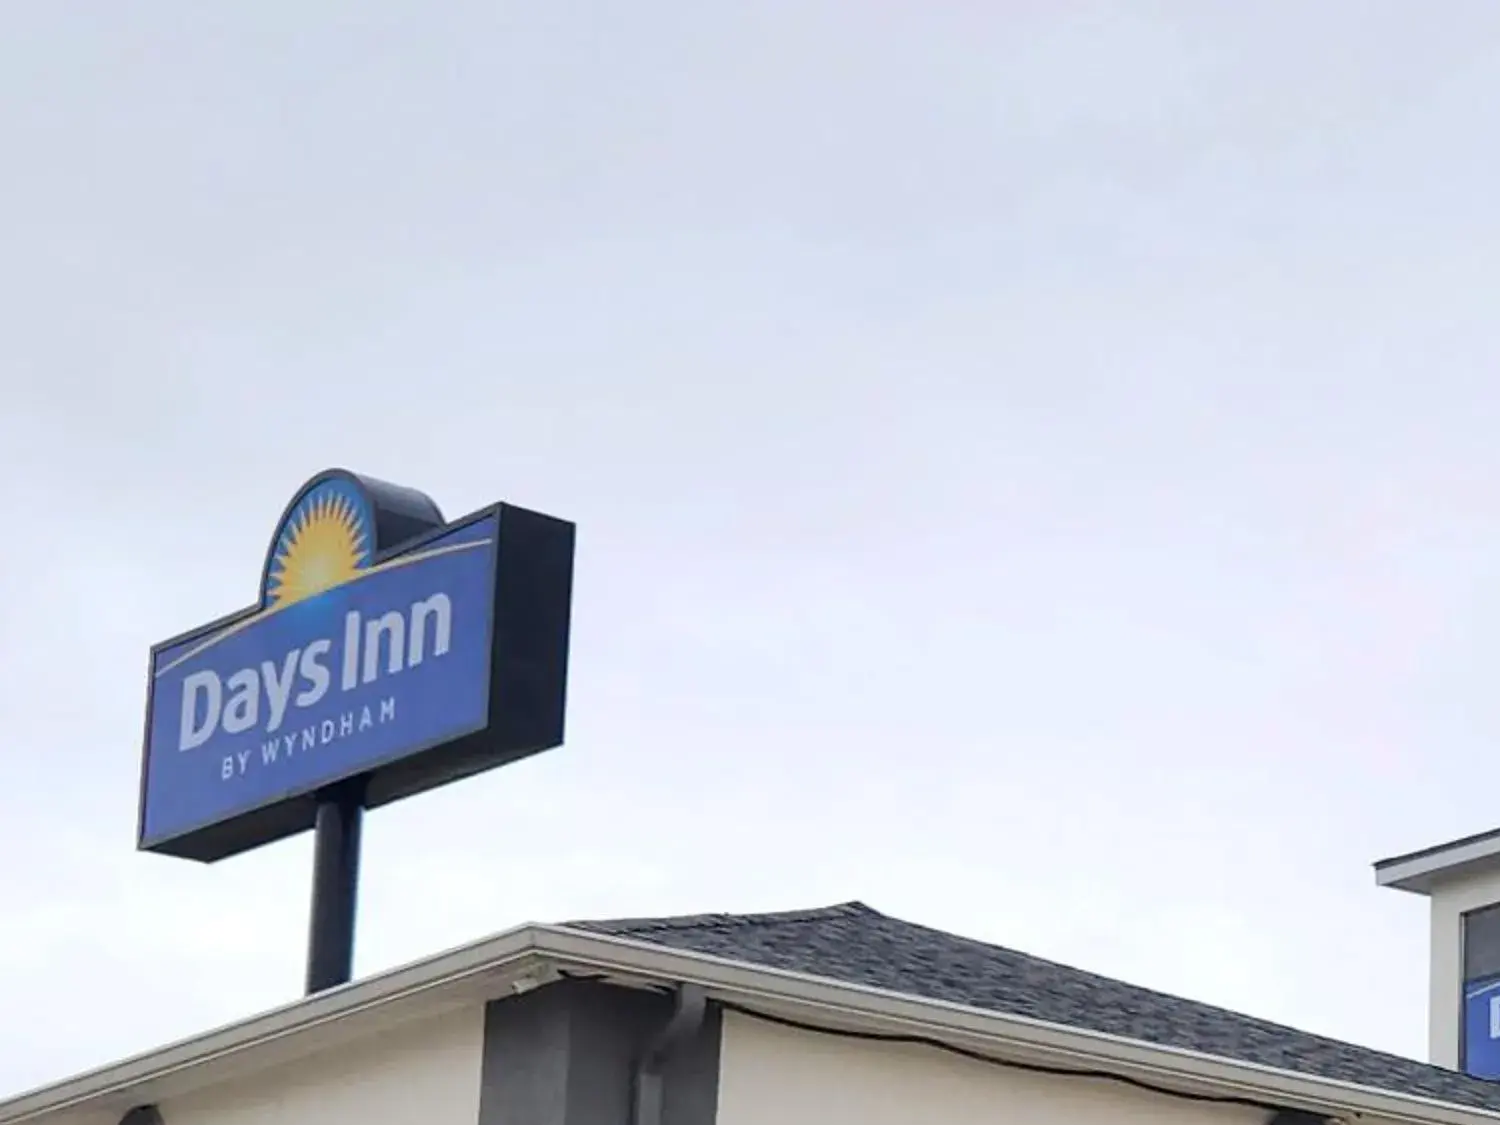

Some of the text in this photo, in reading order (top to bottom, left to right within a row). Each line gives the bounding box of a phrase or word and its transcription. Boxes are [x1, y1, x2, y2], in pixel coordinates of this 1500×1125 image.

[179, 592, 452, 752] Days Inn
[221, 696, 396, 781] BY WYNDHAM
